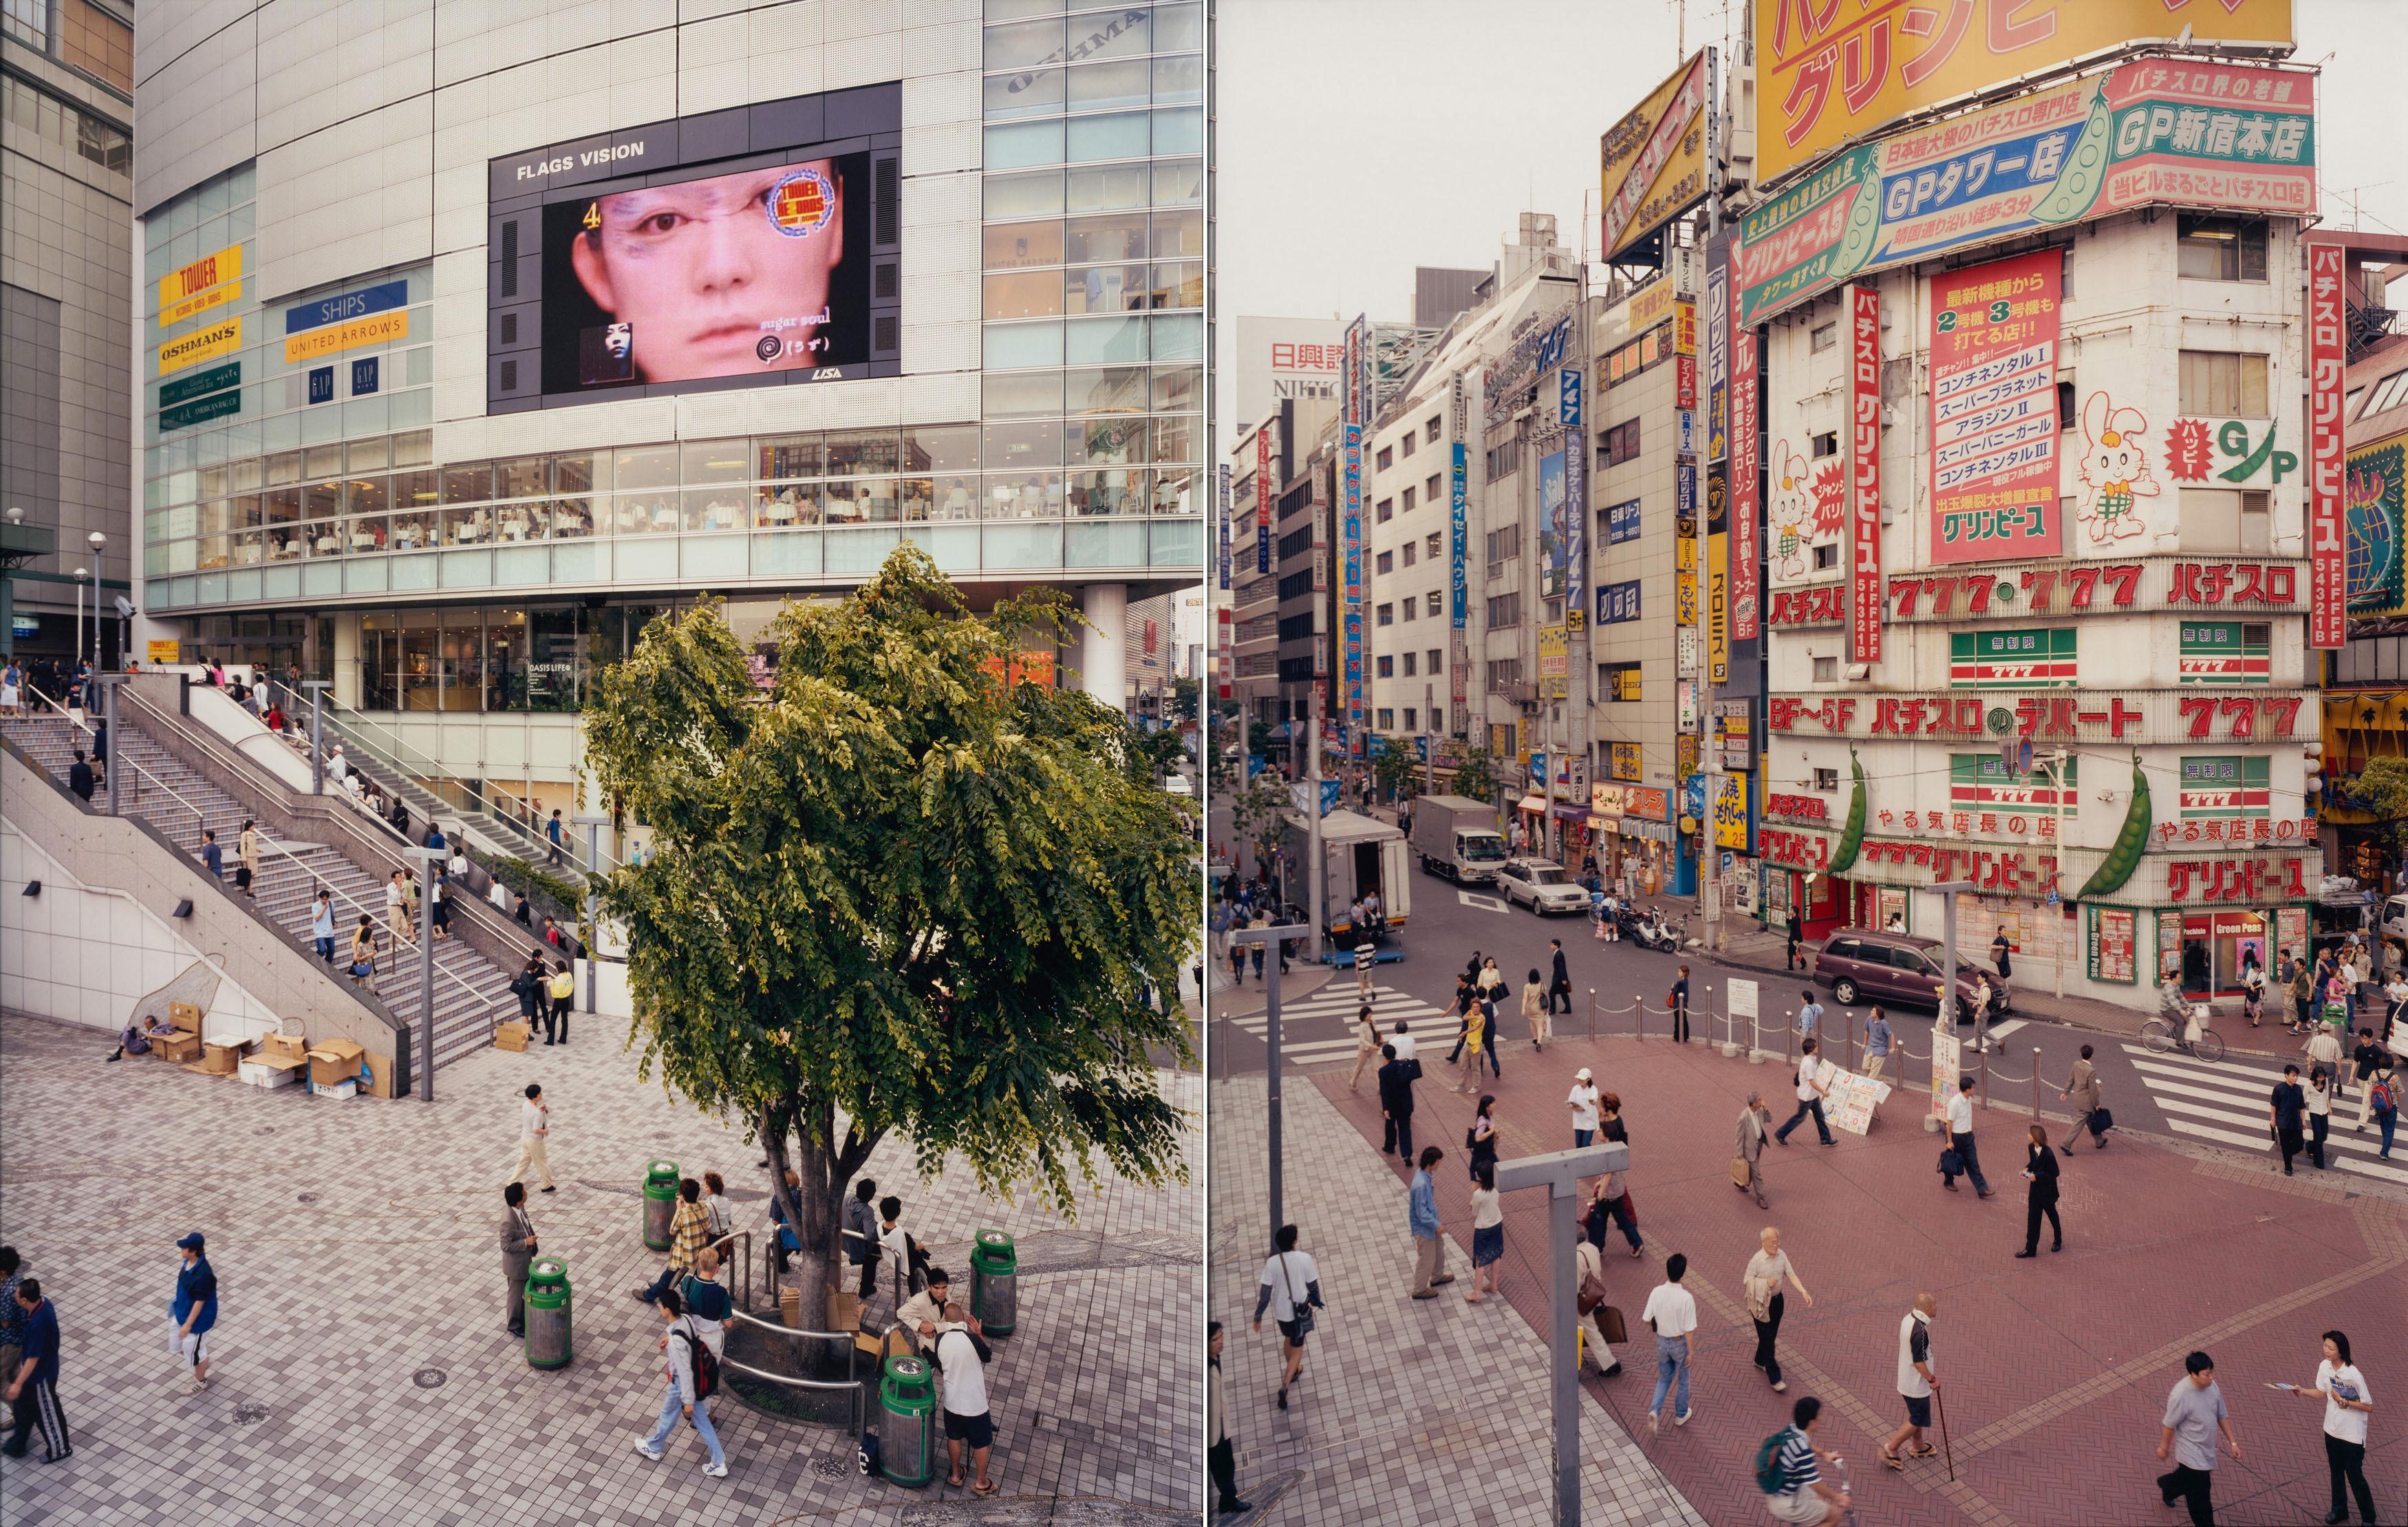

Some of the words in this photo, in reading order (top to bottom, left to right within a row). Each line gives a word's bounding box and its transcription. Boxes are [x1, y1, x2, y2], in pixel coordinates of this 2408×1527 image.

[2129, 68, 2293, 103] パチスロ界の老舗
[1886, 92, 2078, 164] 日本最大級のパチスロ専門店
[2115, 105, 2310, 162] GP新宿本店
[517, 156, 573, 181] FLAGS
[581, 142, 644, 167] VISION
[1885, 132, 2069, 220] GPタワー店
[780, 181, 819, 200] TOWER
[1746, 157, 1854, 239] 史上最強の等価交換店
[2114, 167, 2305, 205] 当ビルまるごとパチスロ店
[582, 202, 601, 229] 4
[777, 197, 824, 217] RECORDS
[1895, 193, 2034, 246] 靖国通り沿い徒歩3分
[180, 257, 217, 297] TOWER
[1946, 273, 2045, 309] 最新機種から
[321, 295, 365, 322] SHIPS
[2314, 250, 2340, 346] パチスロ
[1937, 308, 1985, 334] 2号機
[1989, 299, 2054, 325] 3号機も
[162, 326, 235, 361] OSHMAN'S
[292, 334, 335, 354] UNITED
[341, 320, 400, 343] ARROWS
[1856, 293, 1878, 384] パチスロ
[312, 374, 330, 397] GAP
[357, 365, 374, 384] GAP
[811, 368, 842, 380] LISA
[1939, 352, 2034, 395] コンチネンタル
[1563, 372, 1579, 423] 747
[1939, 372, 2047, 419] スーパープラネット
[1733, 381, 1744, 496] 不動産担保ローン
[1745, 378, 1755, 491] キャッシングローン
[1938, 416, 2052, 464] スーパーバニーガール
[2181, 423, 2198, 475] ハッピー
[2314, 359, 2342, 551] グリンピース
[1679, 467, 1690, 509] リッチ
[1856, 392, 1879, 574] グリンピース
[1935, 486, 2054, 513] 出玉爆裂大増量宣言
[1943, 505, 2046, 544] グリンピース
[1569, 530, 1582, 607] 747
[2167, 564, 2296, 604] パチスロ
[1569, 611, 1582, 630] 5F
[1600, 587, 1636, 623] リッチ
[1712, 573, 1725, 655] プロミス
[1770, 586, 1845, 625] パチスロ
[1992, 636, 2034, 650] 無制限
[2183, 628, 2227, 643] 無制限
[1992, 665, 2034, 678] 777
[2182, 659, 2226, 672] 777
[2180, 696, 2303, 737] 777
[2186, 763, 2233, 778] 無制限
[1635, 789, 1665, 809] クレープ
[1767, 793, 1825, 819] パチスロ
[1991, 788, 2035, 803] 777
[2186, 793, 2233, 807] 777
[1732, 831, 1746, 848] 2F
[1878, 810, 2056, 837] やる気店長の店
[2158, 817, 2318, 844] やる気店長の店
[1722, 853, 1732, 873] P
[1758, 829, 1829, 873] グリンピース
[2168, 858, 2307, 901] グリンピース
[2091, 932, 2100, 957] Green
[2216, 924, 2241, 935] Green
[2242, 923, 2262, 933] Peas
[2091, 958, 2100, 978] Peas
